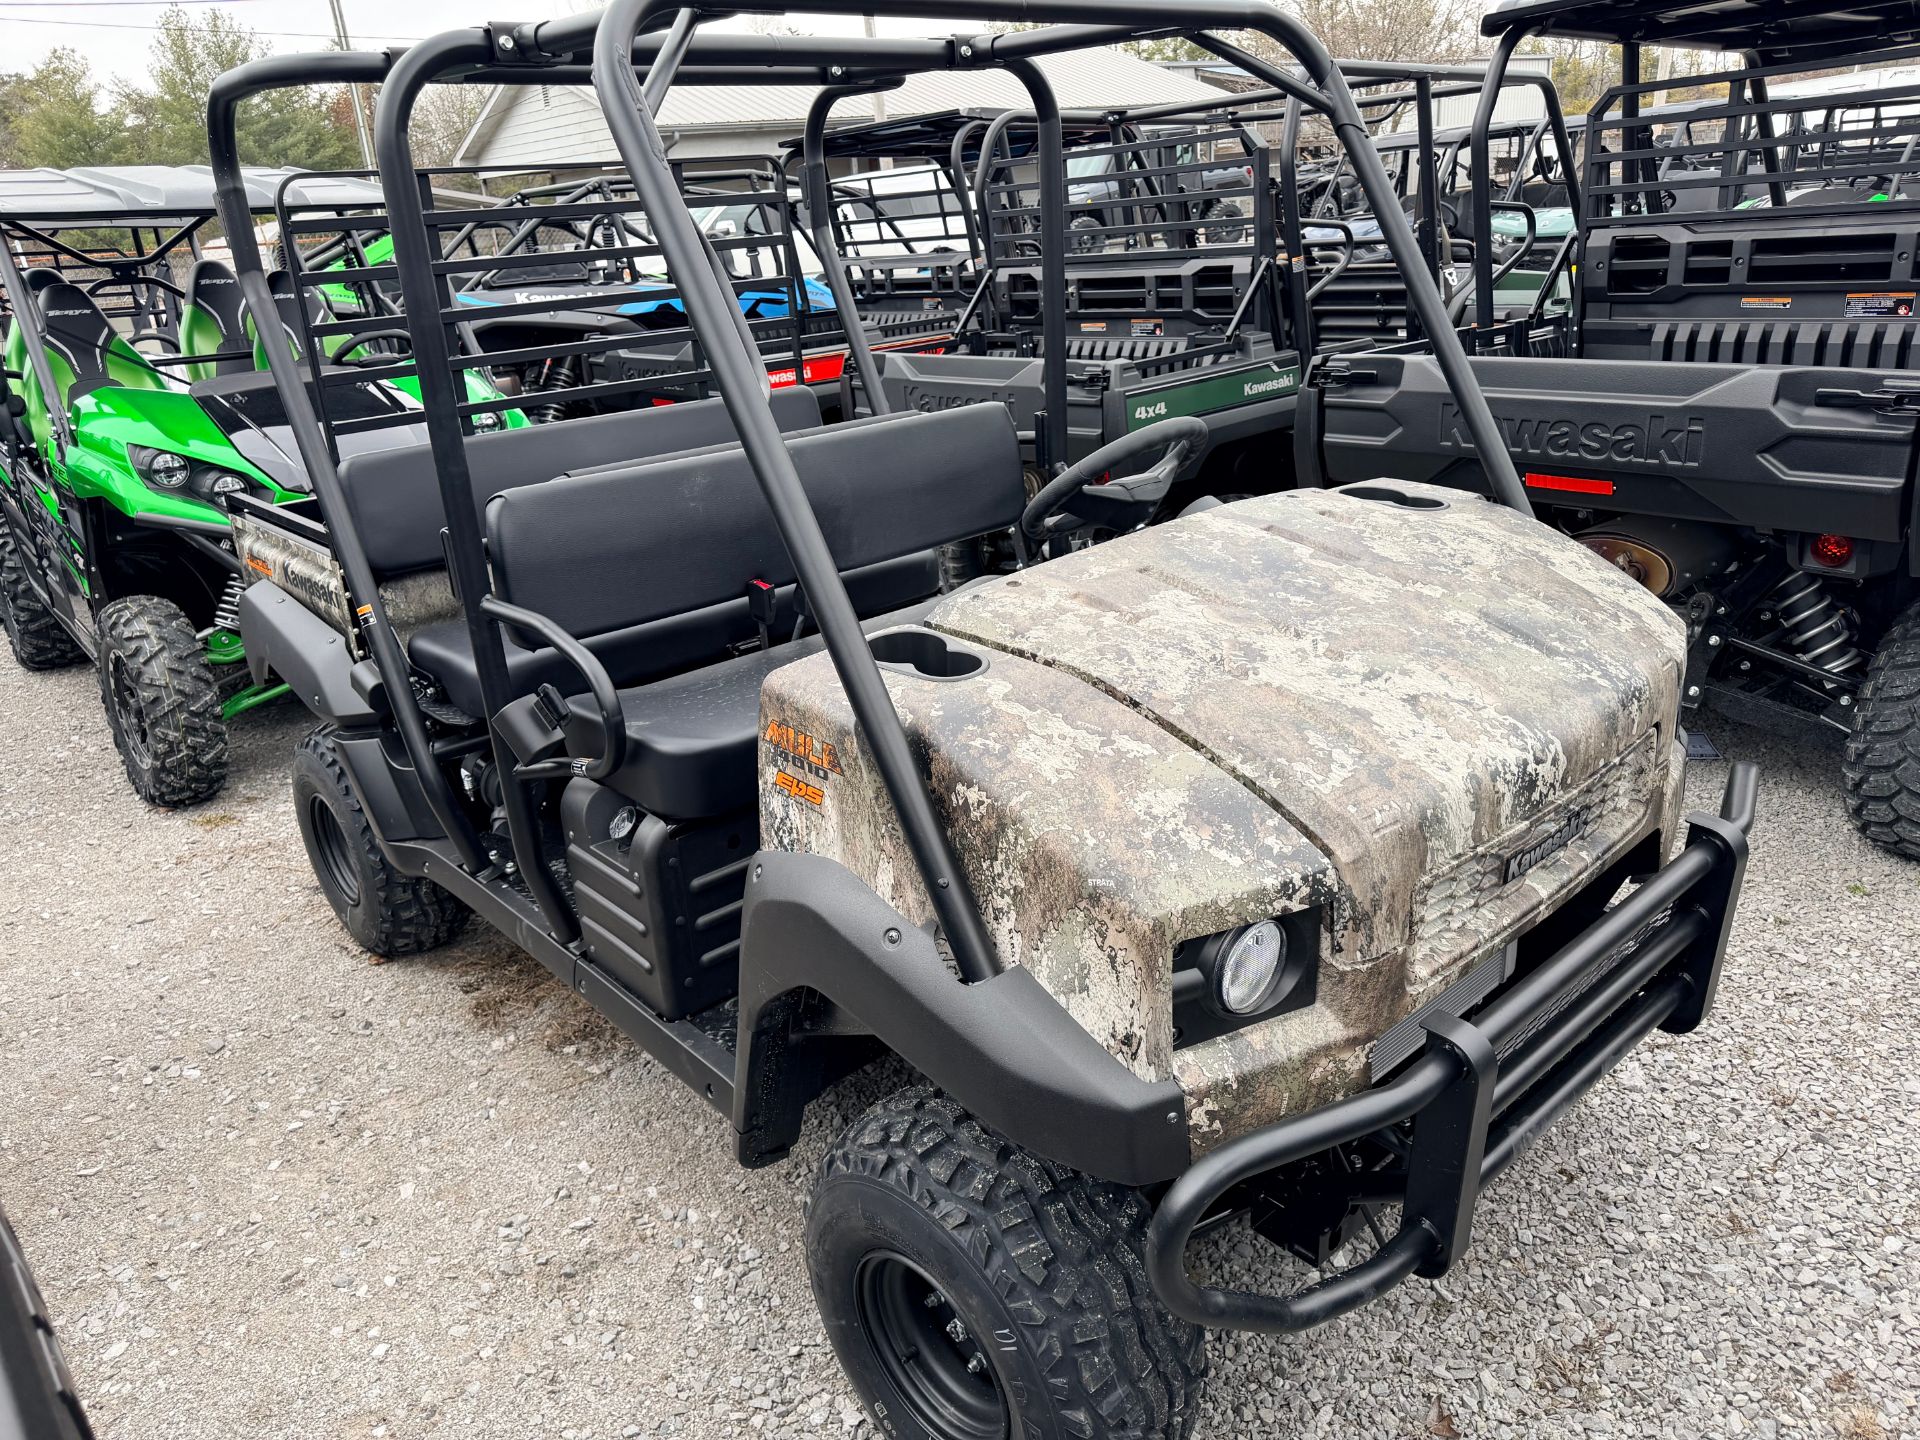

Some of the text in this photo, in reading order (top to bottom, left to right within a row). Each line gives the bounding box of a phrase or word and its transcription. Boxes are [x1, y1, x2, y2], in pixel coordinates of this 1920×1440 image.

[1244, 373, 1294, 396] Kawasaki
[1135, 401, 1167, 420] 4x4
[283, 562, 340, 608] Kawasaki
[1507, 807, 1590, 882] Kawasaki
[1087, 878, 1117, 889] STRATA
